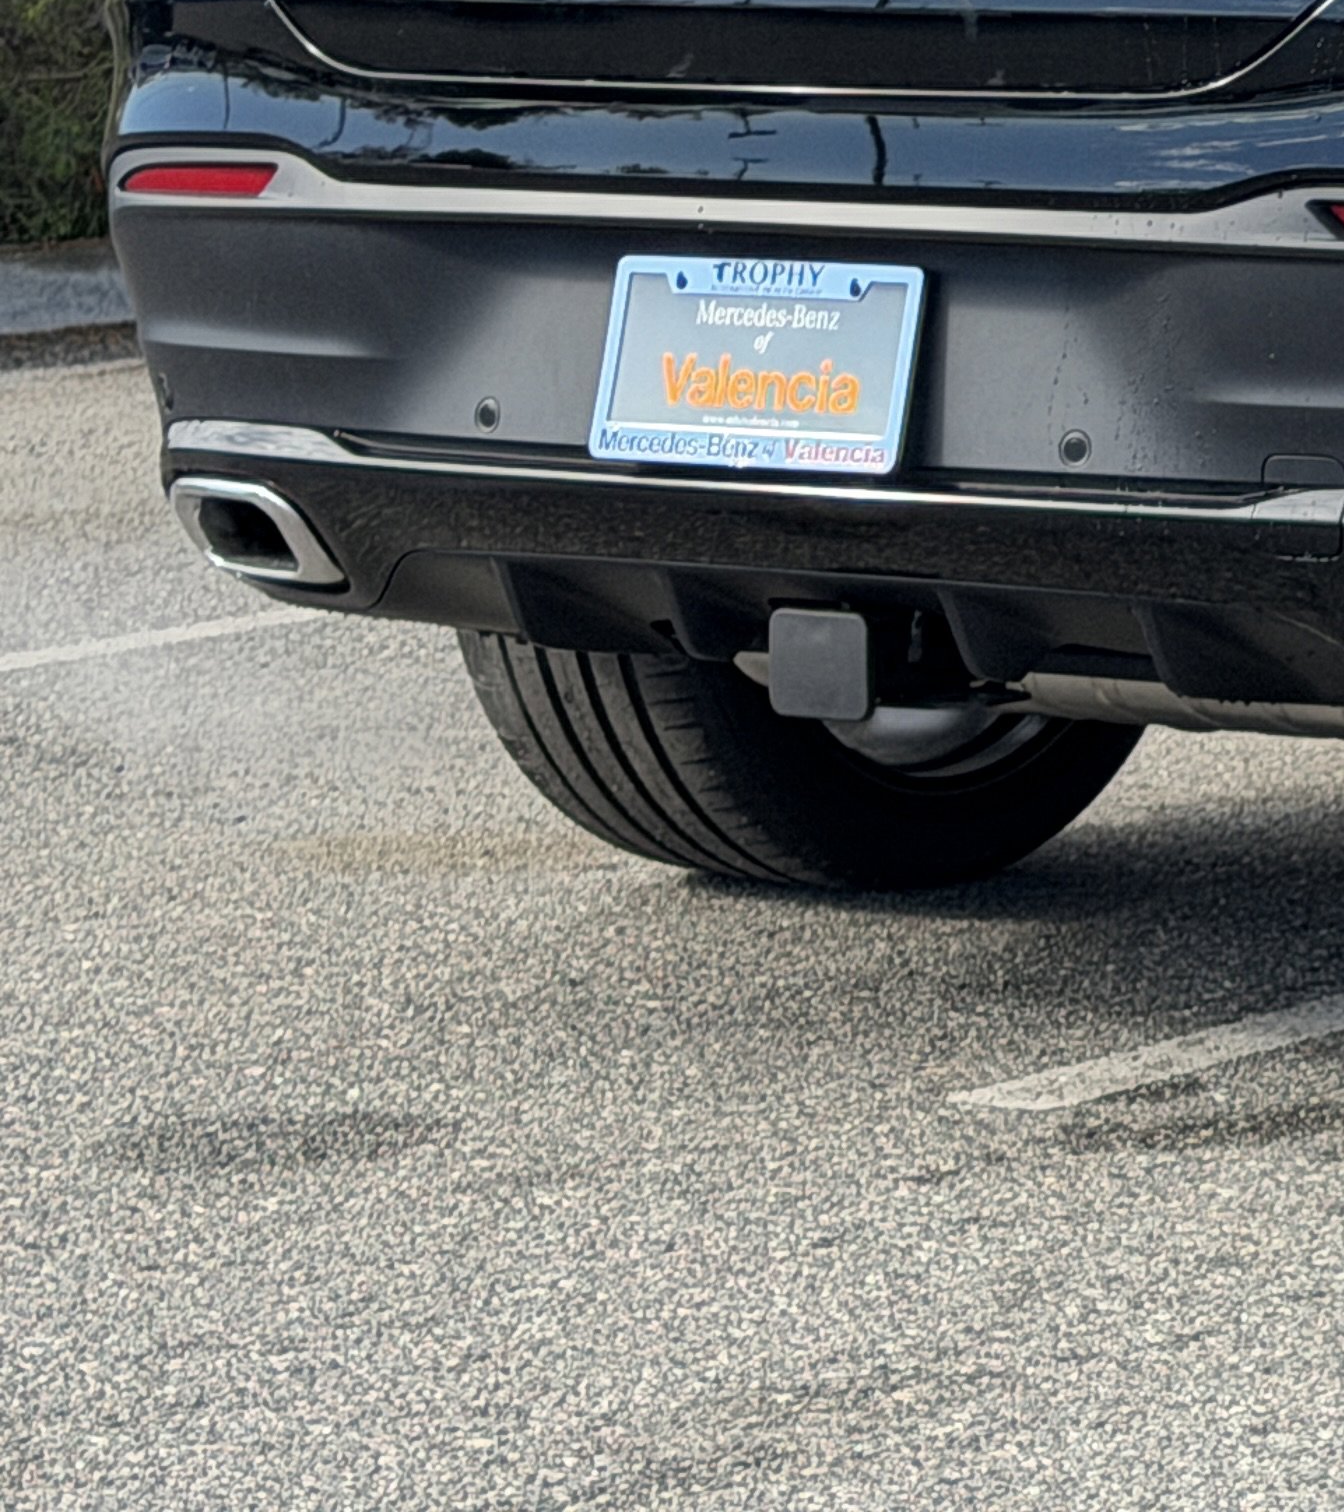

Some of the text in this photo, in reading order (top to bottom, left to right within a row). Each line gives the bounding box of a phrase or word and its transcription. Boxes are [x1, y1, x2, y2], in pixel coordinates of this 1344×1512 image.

[712, 261, 826, 287] TROPHY
[696, 299, 840, 330] Mercedes-Benz
[753, 331, 774, 354] of
[662, 352, 860, 415] Valencia
[598, 427, 759, 459] Mercedes-Benz
[784, 437, 885, 464] Valencia
